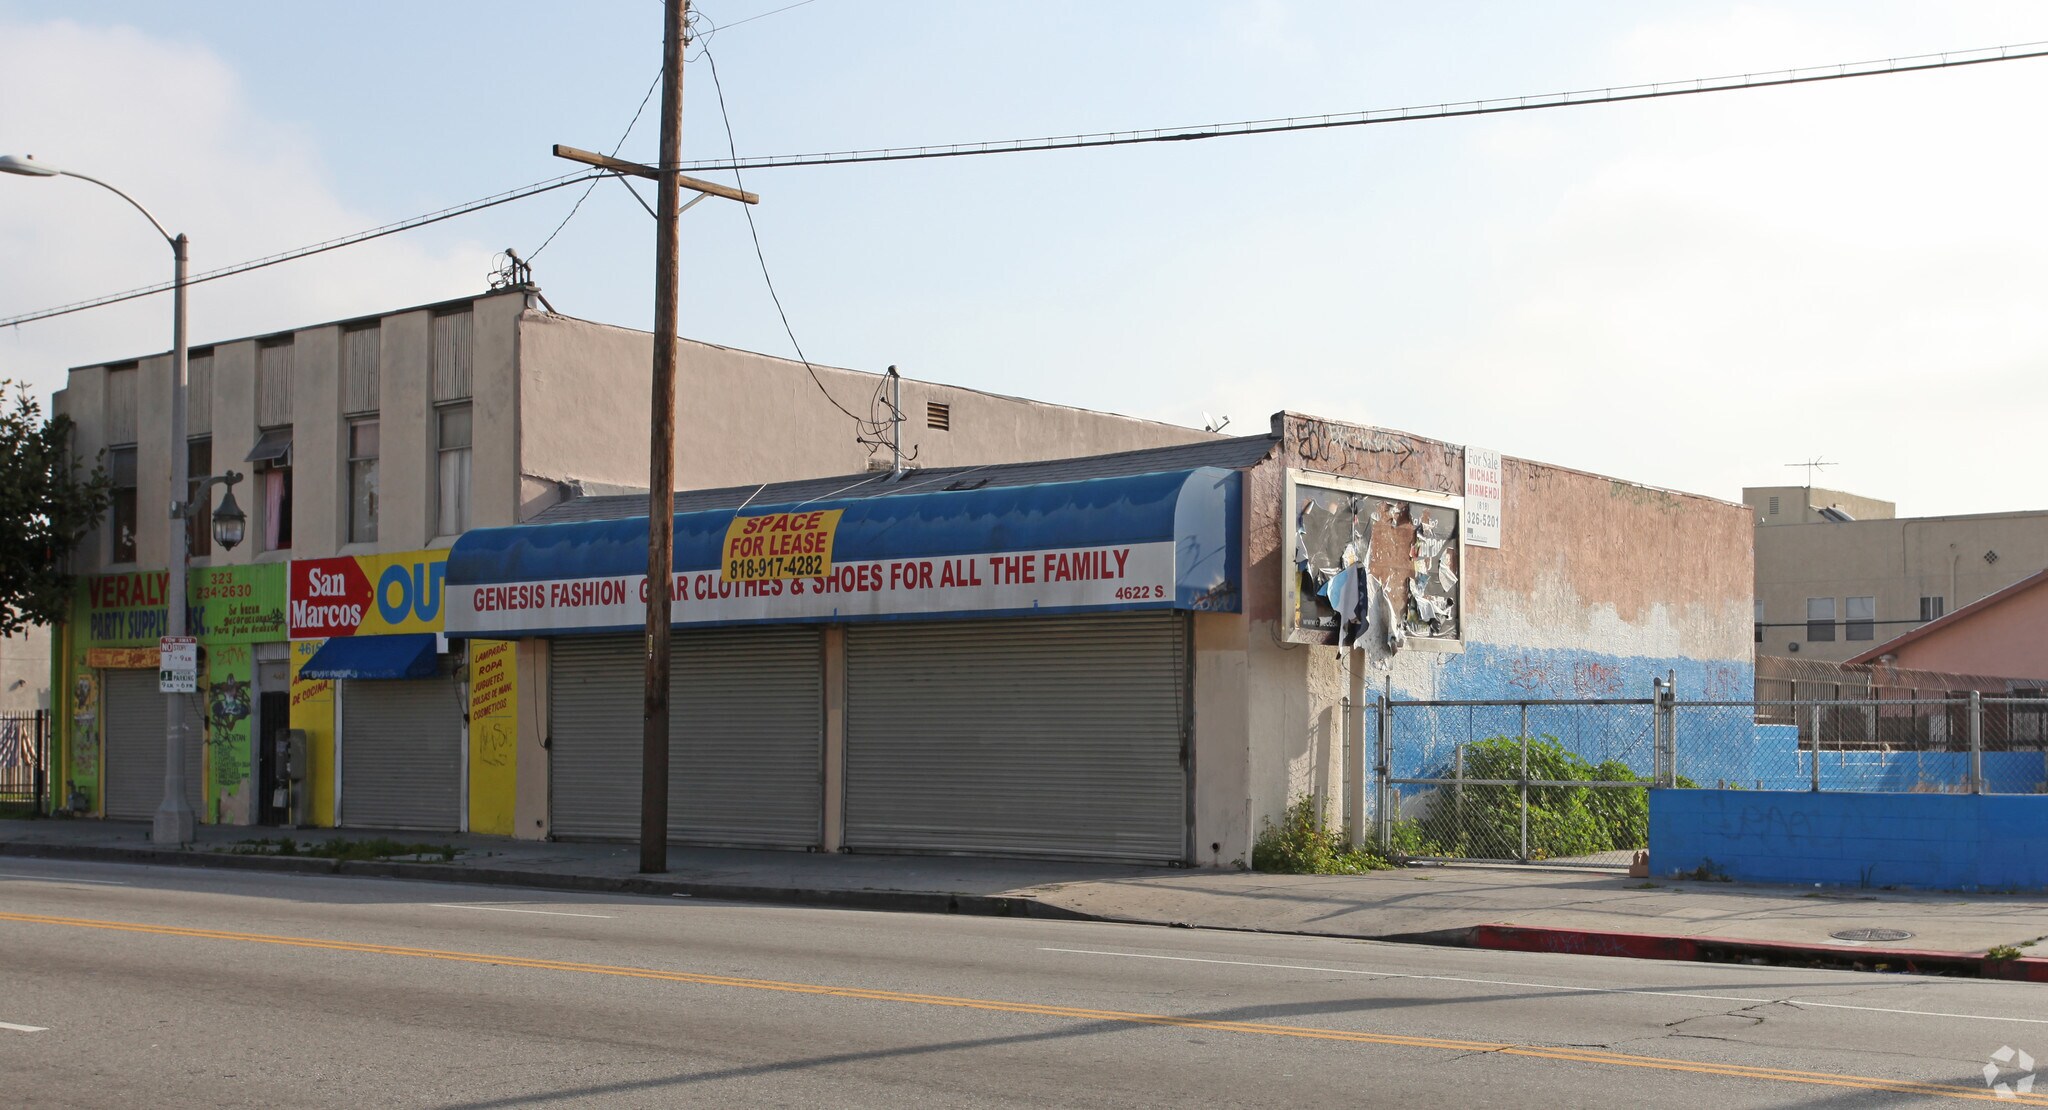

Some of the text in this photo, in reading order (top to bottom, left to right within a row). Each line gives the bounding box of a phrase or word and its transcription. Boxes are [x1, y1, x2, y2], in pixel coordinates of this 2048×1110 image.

[1467, 449, 1481, 465] For
[1483, 452, 1498, 469] Sale
[1469, 468, 1498, 484] MICHAEL
[1467, 483, 1500, 500] MIRMEHDI
[743, 512, 825, 534] SPACE
[1466, 511, 1499, 528] 326-5201
[729, 531, 828, 558] FOR LEASE
[729, 554, 823, 579] 818-917-4282
[211, 573, 232, 584] 323
[308, 567, 346, 597] San
[473, 548, 1131, 612] GENESIS FASHION GR CLOTHES & SHOES FOR ALL THE FAMILY
[1115, 586, 1150, 600] 4622
[91, 612, 125, 640] PARTY
[127, 608, 168, 640] SUPPLY
[291, 599, 361, 628] Marcos
[162, 643, 173, 651] NO
[475, 642, 508, 663] LAMPARAS
[478, 659, 502, 676] ROPA
[292, 693, 302, 706] DE
[302, 680, 328, 701] COCINA
[473, 672, 505, 693] JUGUETES
[473, 698, 507, 720] COSMETICOS
